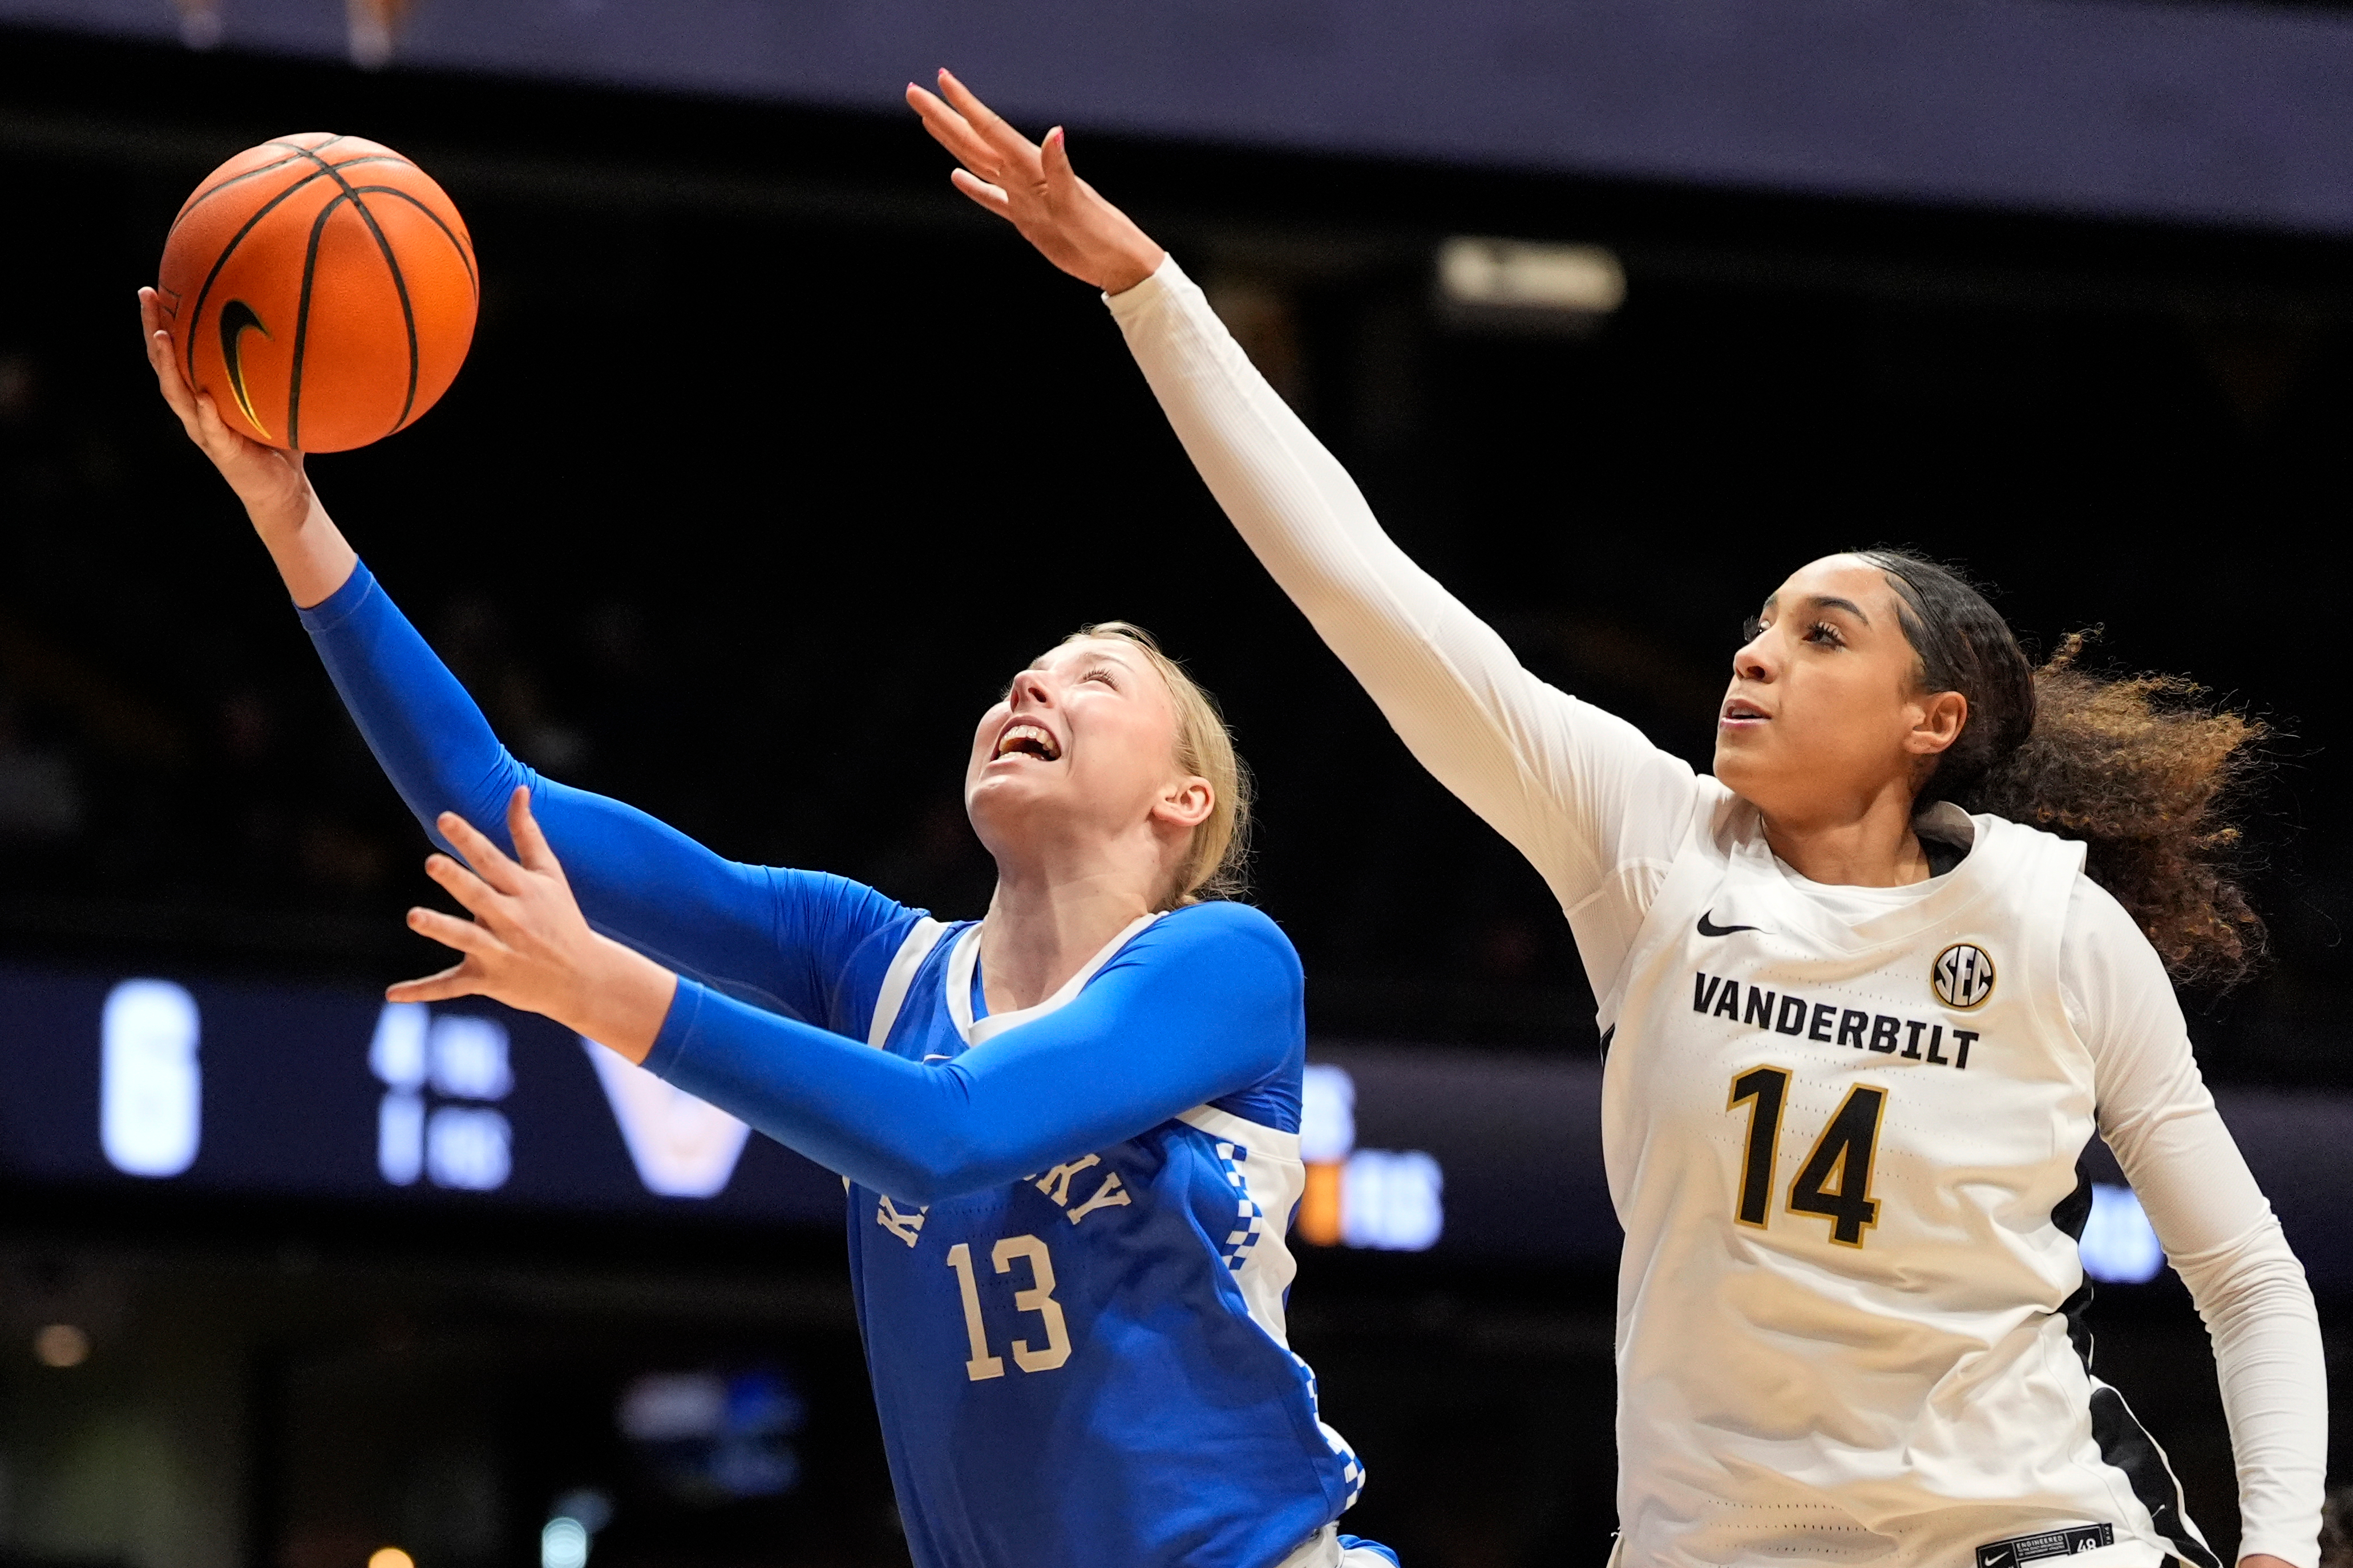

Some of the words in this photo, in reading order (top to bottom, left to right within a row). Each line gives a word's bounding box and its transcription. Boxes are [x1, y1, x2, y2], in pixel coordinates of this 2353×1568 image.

[1935, 945, 1994, 1007] SEC
[1693, 971, 1979, 1070] VANDERBILT
[1726, 1063, 1889, 1249] 14
[947, 1234, 1072, 1381] 13
[2016, 1535, 2063, 1549] ENGINEERED
[2077, 1538, 2097, 1553] 48
